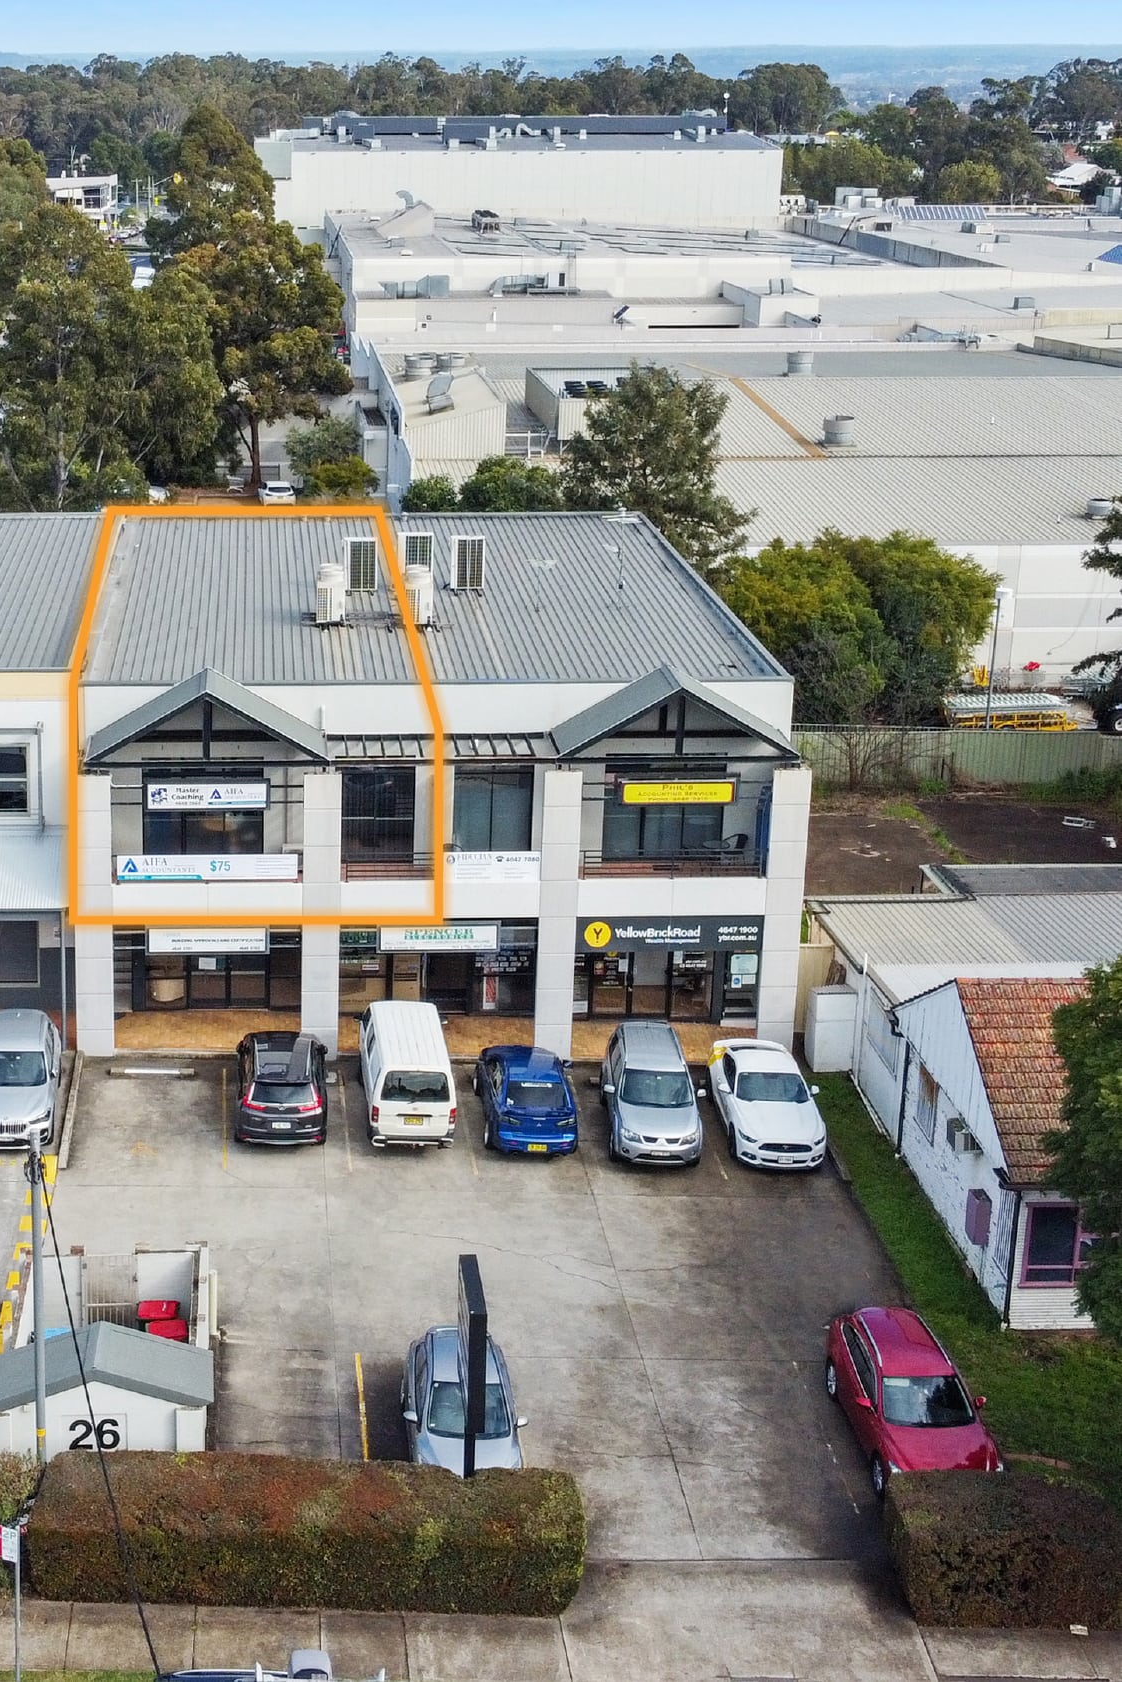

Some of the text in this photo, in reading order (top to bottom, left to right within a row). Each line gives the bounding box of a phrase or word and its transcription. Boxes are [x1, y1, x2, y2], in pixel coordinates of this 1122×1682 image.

[171, 793, 204, 801] Coaching
[209, 860, 231, 872] $75
[614, 925, 701, 939] YellowBrickRoad
[717, 926, 759, 934] 4647 1900
[717, 934, 758, 943] ybr.com.au
[69, 1418, 120, 1450] 26
